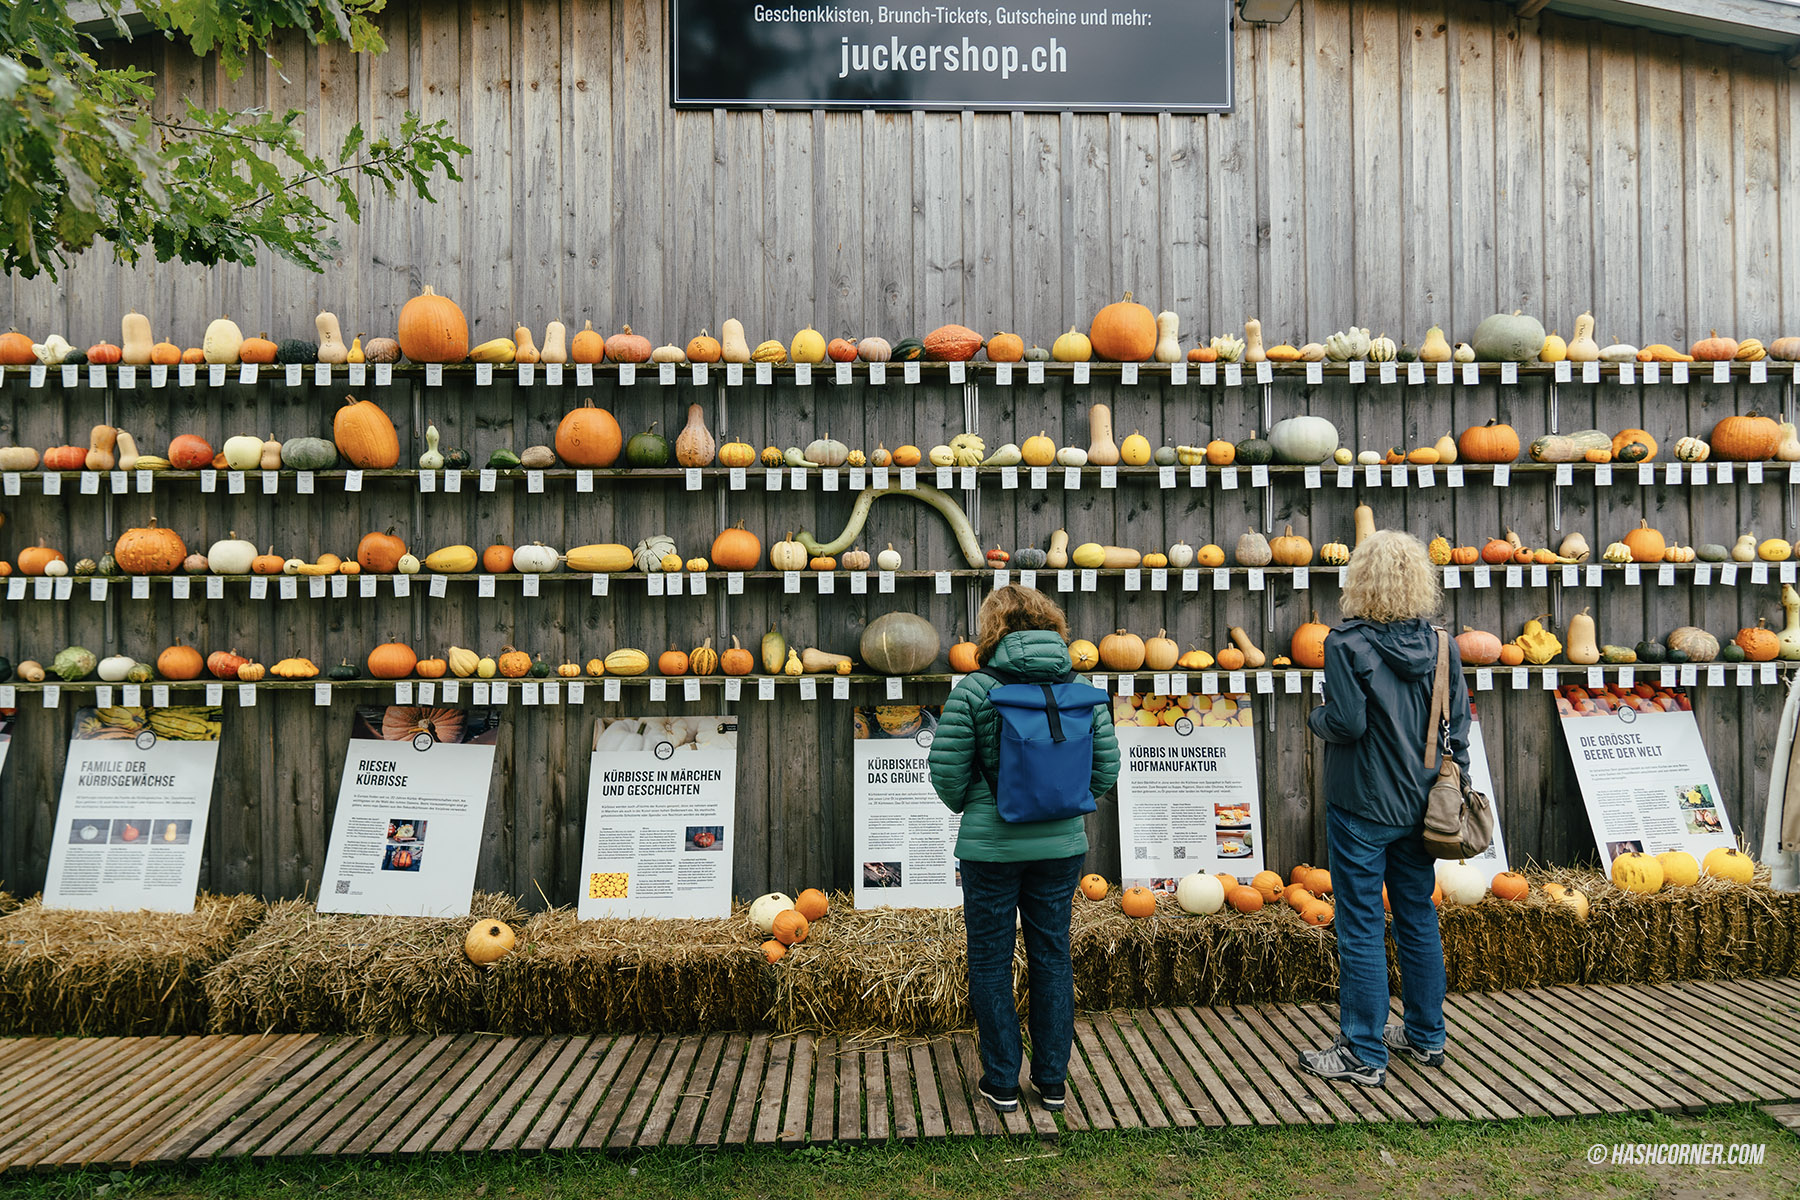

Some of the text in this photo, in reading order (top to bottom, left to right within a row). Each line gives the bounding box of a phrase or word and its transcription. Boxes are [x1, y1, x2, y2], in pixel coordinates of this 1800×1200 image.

[754, 5, 1152, 26] Geschenkkisten, Brunch-Tickets, Gutscheine und mehr:
[839, 36, 1067, 80] juckershop.ch
[1579, 732, 1643, 748] DIE GRÖSSTE
[1129, 745, 1227, 758] KÜRBIS IN UNSERER
[1583, 745, 1663, 760] BEERE DER WELT
[80, 761, 147, 773] FAMILIE DER
[358, 760, 397, 773] RIESEN
[1129, 760, 1218, 772] HOFMANUFAKTUR
[78, 773, 176, 787] KÜRBISGEWÄCHSE
[355, 772, 409, 787] KÜRBISSE
[603, 768, 721, 783] KÜRBISSE IN MÄRCHEN
[867, 772, 888, 784] DAS
[890, 770, 925, 784] GRÜNE
[602, 783, 701, 797] UND GESCHICHTEN
